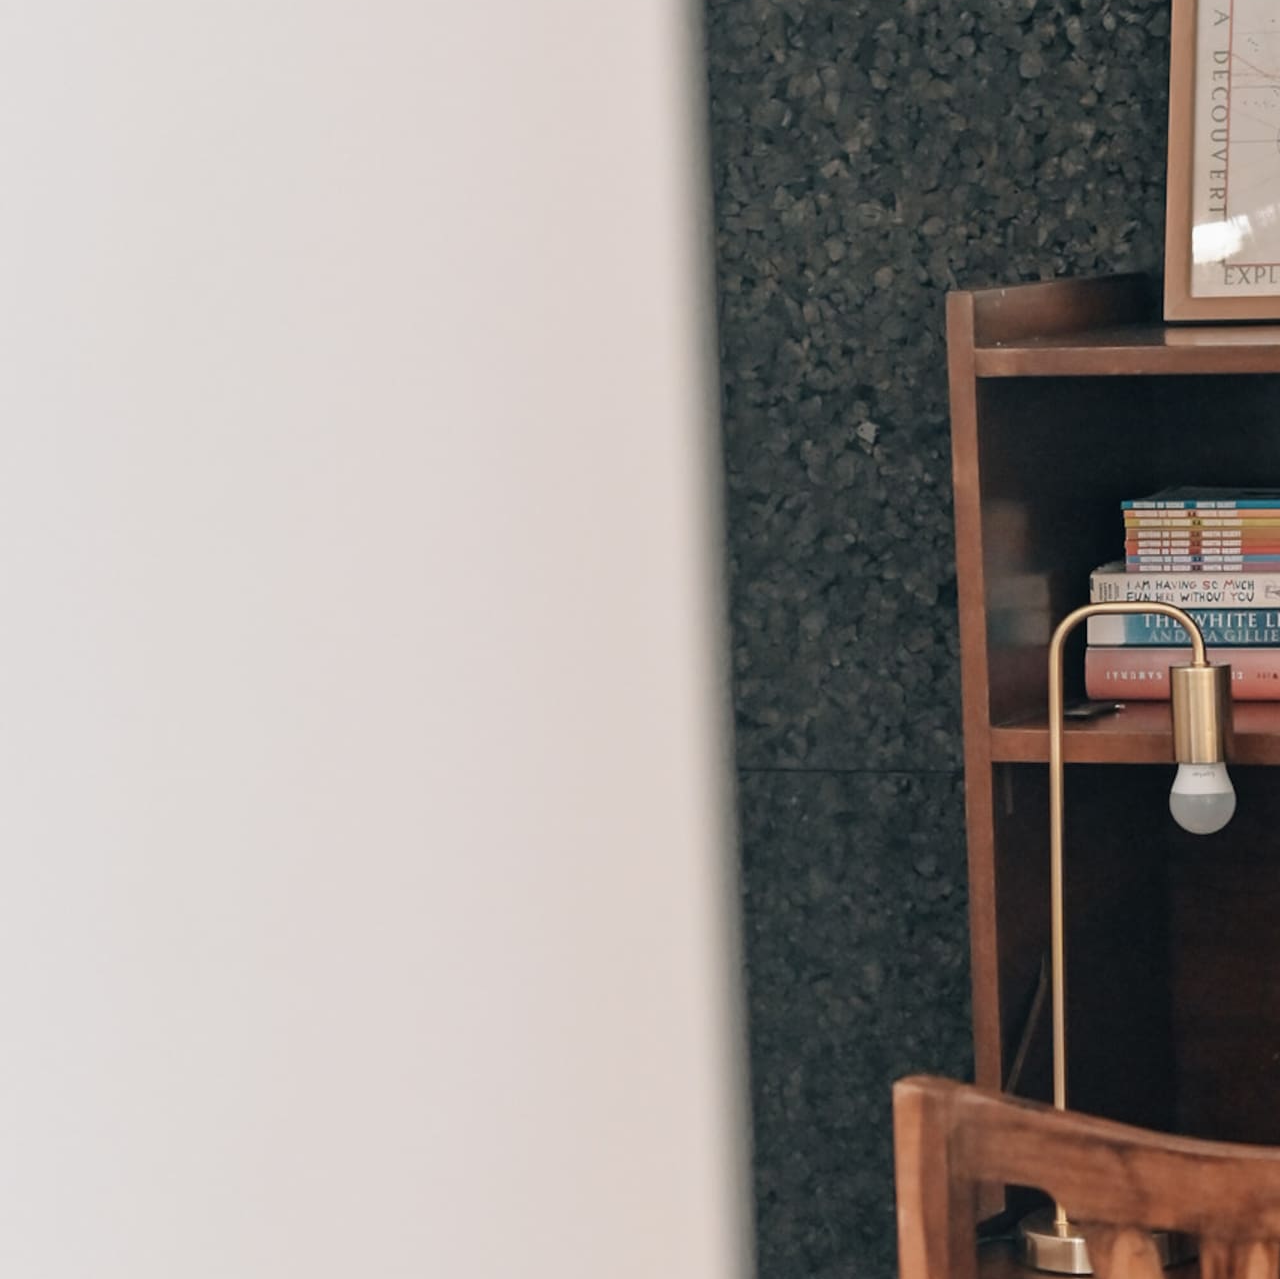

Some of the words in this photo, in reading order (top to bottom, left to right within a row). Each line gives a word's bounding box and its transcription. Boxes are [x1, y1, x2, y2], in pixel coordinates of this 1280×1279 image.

[1213, 8, 1230, 26] A
[1135, 580, 1151, 590] AM
[1156, 580, 1197, 590] HAVING
[1223, 579, 1254, 591] MUCH
[1180, 591, 1226, 602] WITHOUT
[1231, 591, 1255, 602] YOU
[1195, 612, 1257, 628] WHITE
